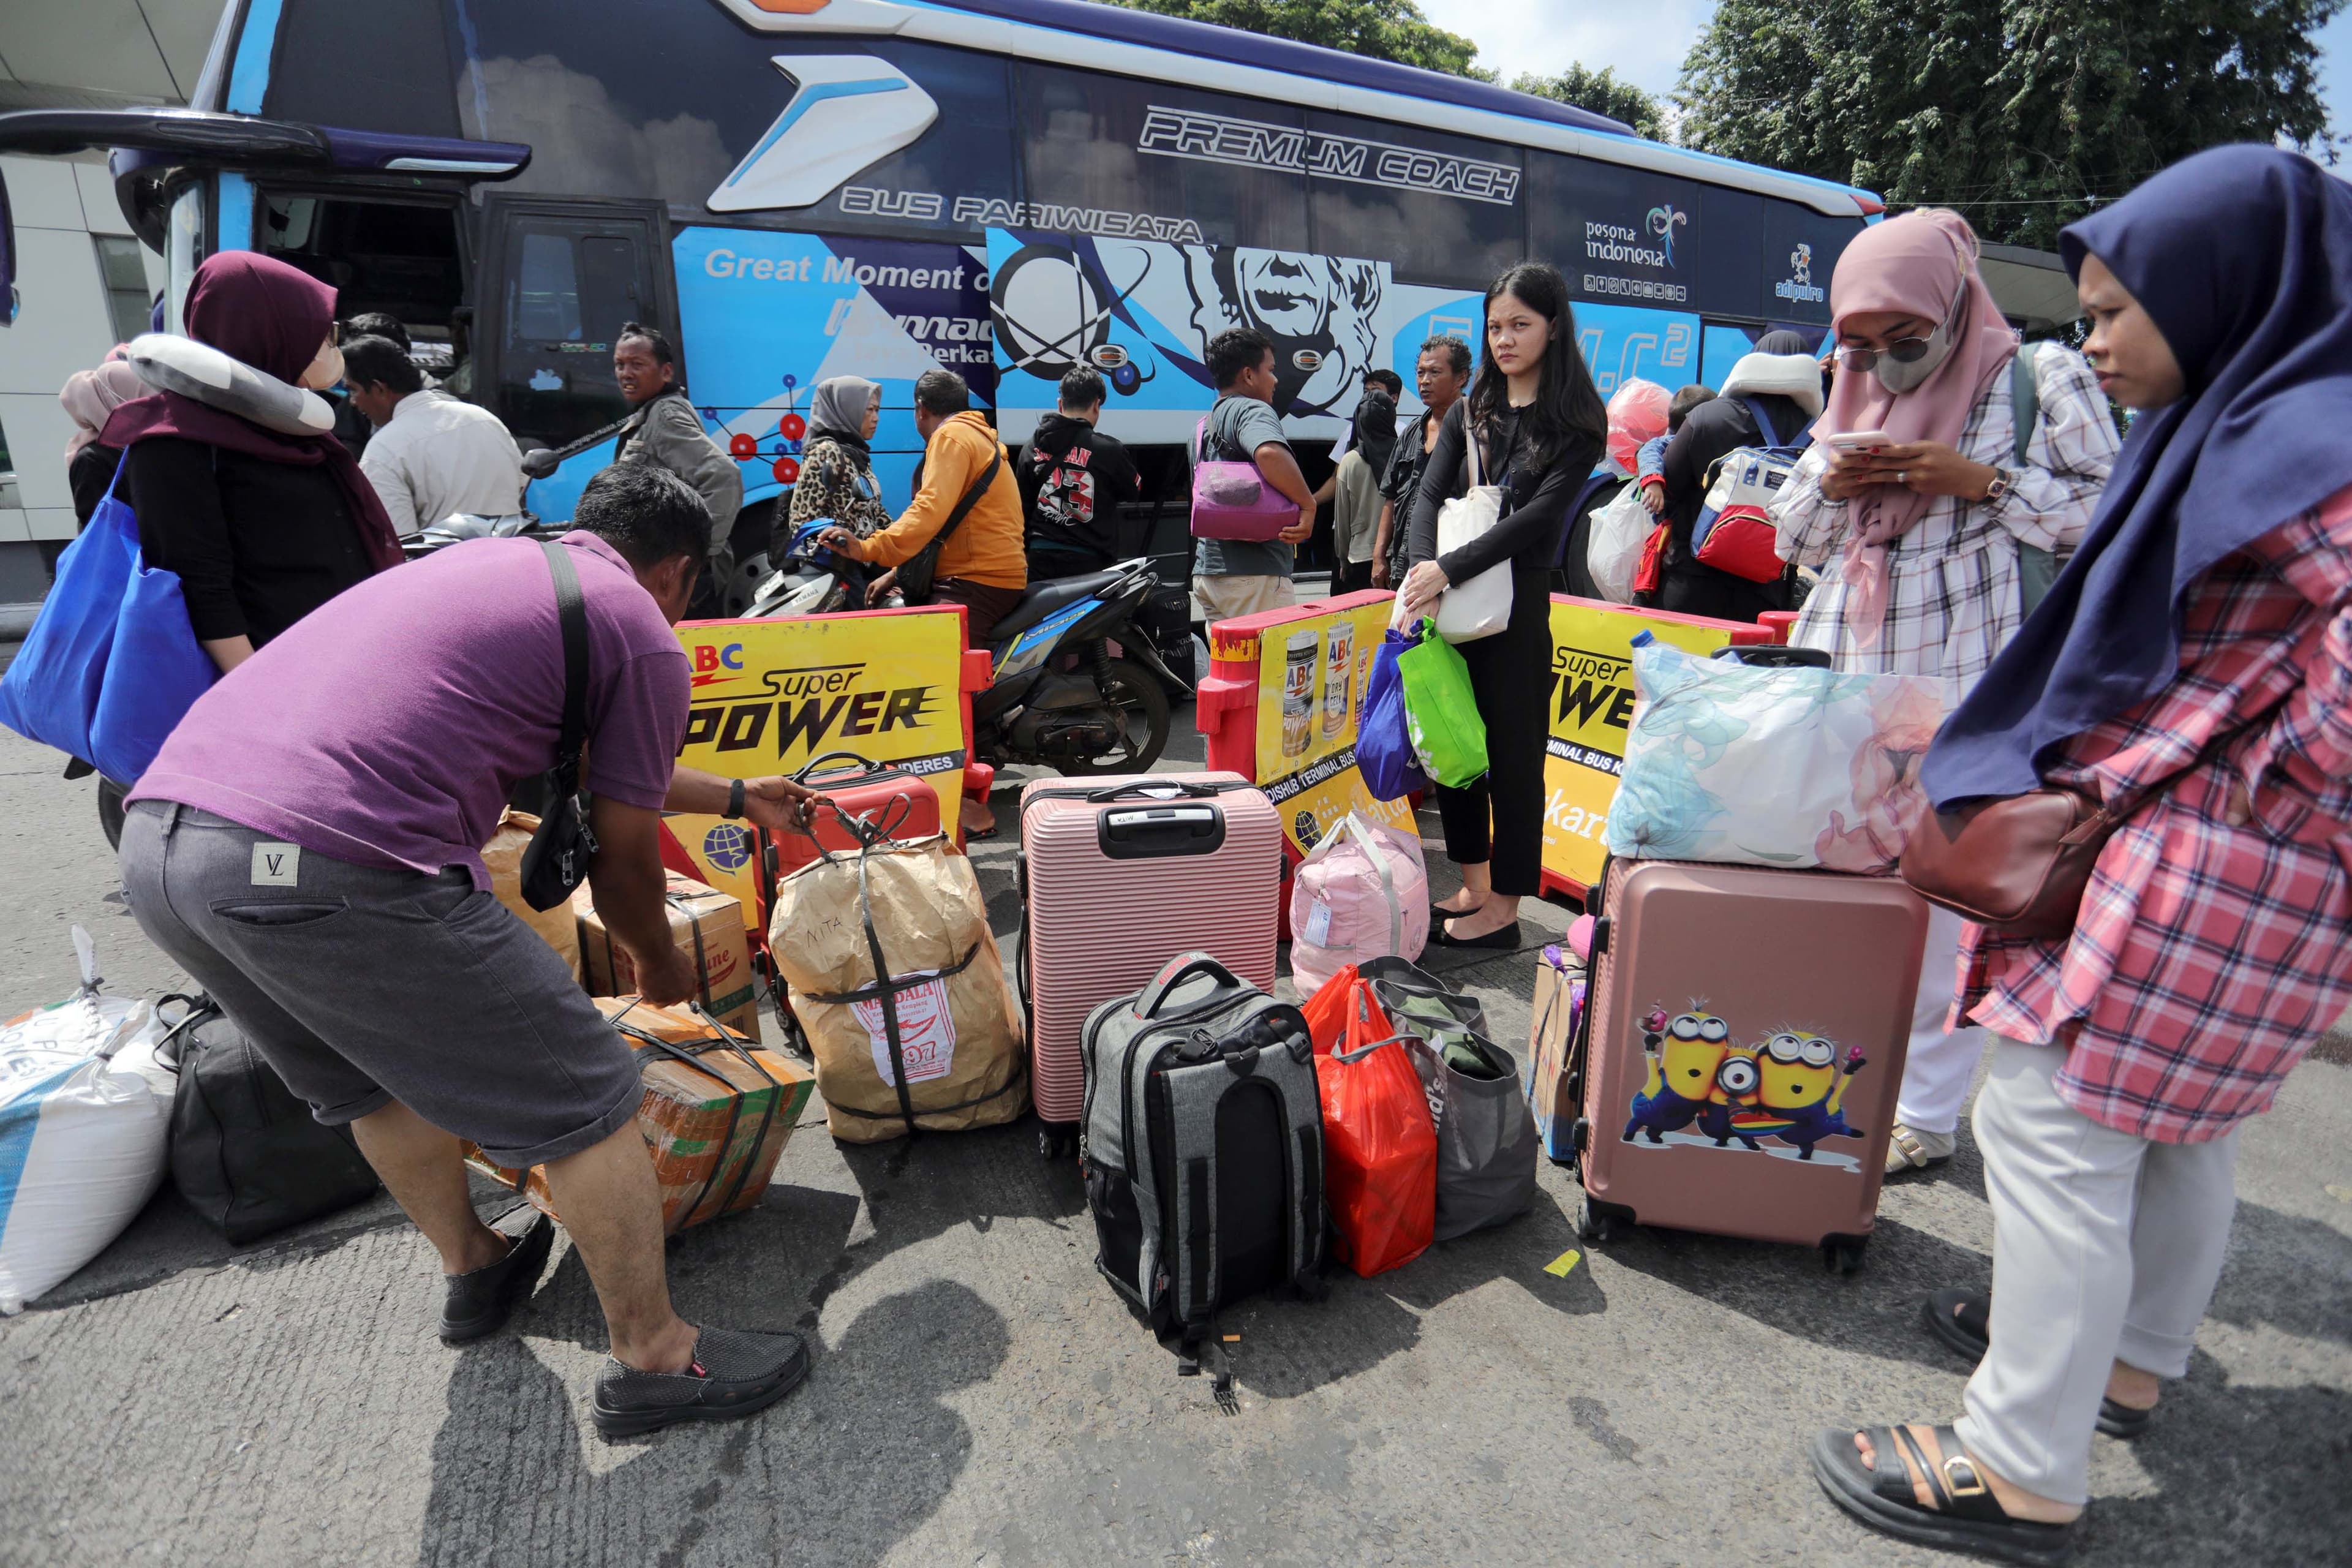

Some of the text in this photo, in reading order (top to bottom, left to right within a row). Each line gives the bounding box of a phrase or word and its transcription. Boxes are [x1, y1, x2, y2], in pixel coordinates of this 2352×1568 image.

[1140, 111, 1519, 200] PREMIUM COACH
[840, 186, 1204, 244] BUS PARIWISATA
[1585, 221, 1636, 241] pesona
[1585, 239, 1666, 268] indonesia
[705, 249, 808, 283] Great
[821, 256, 965, 289] Moment
[1776, 281, 1823, 303] adiputro
[795, 589, 819, 603] YAMAHA
[690, 643, 744, 672] BC
[1329, 636, 1352, 662] ABC
[1358, 657, 1367, 668] ABC
[1287, 663, 1313, 687] ABC
[1551, 646, 1632, 682] Super
[762, 663, 865, 699] Super
[1331, 681, 1342, 693] DRY
[1330, 695, 1341, 706] CELL
[677, 685, 943, 761] POWER
[1546, 739, 1582, 761] MINAL
[1583, 752, 1612, 770] BUS
[1265, 778, 1300, 804] DISHUB
[1300, 759, 1341, 788] TERMINAL
[1338, 751, 1355, 767] BUS
[807, 916, 843, 948] NITA
[861, 981, 934, 1011] MADALA
[888, 1041, 936, 1066] 97
